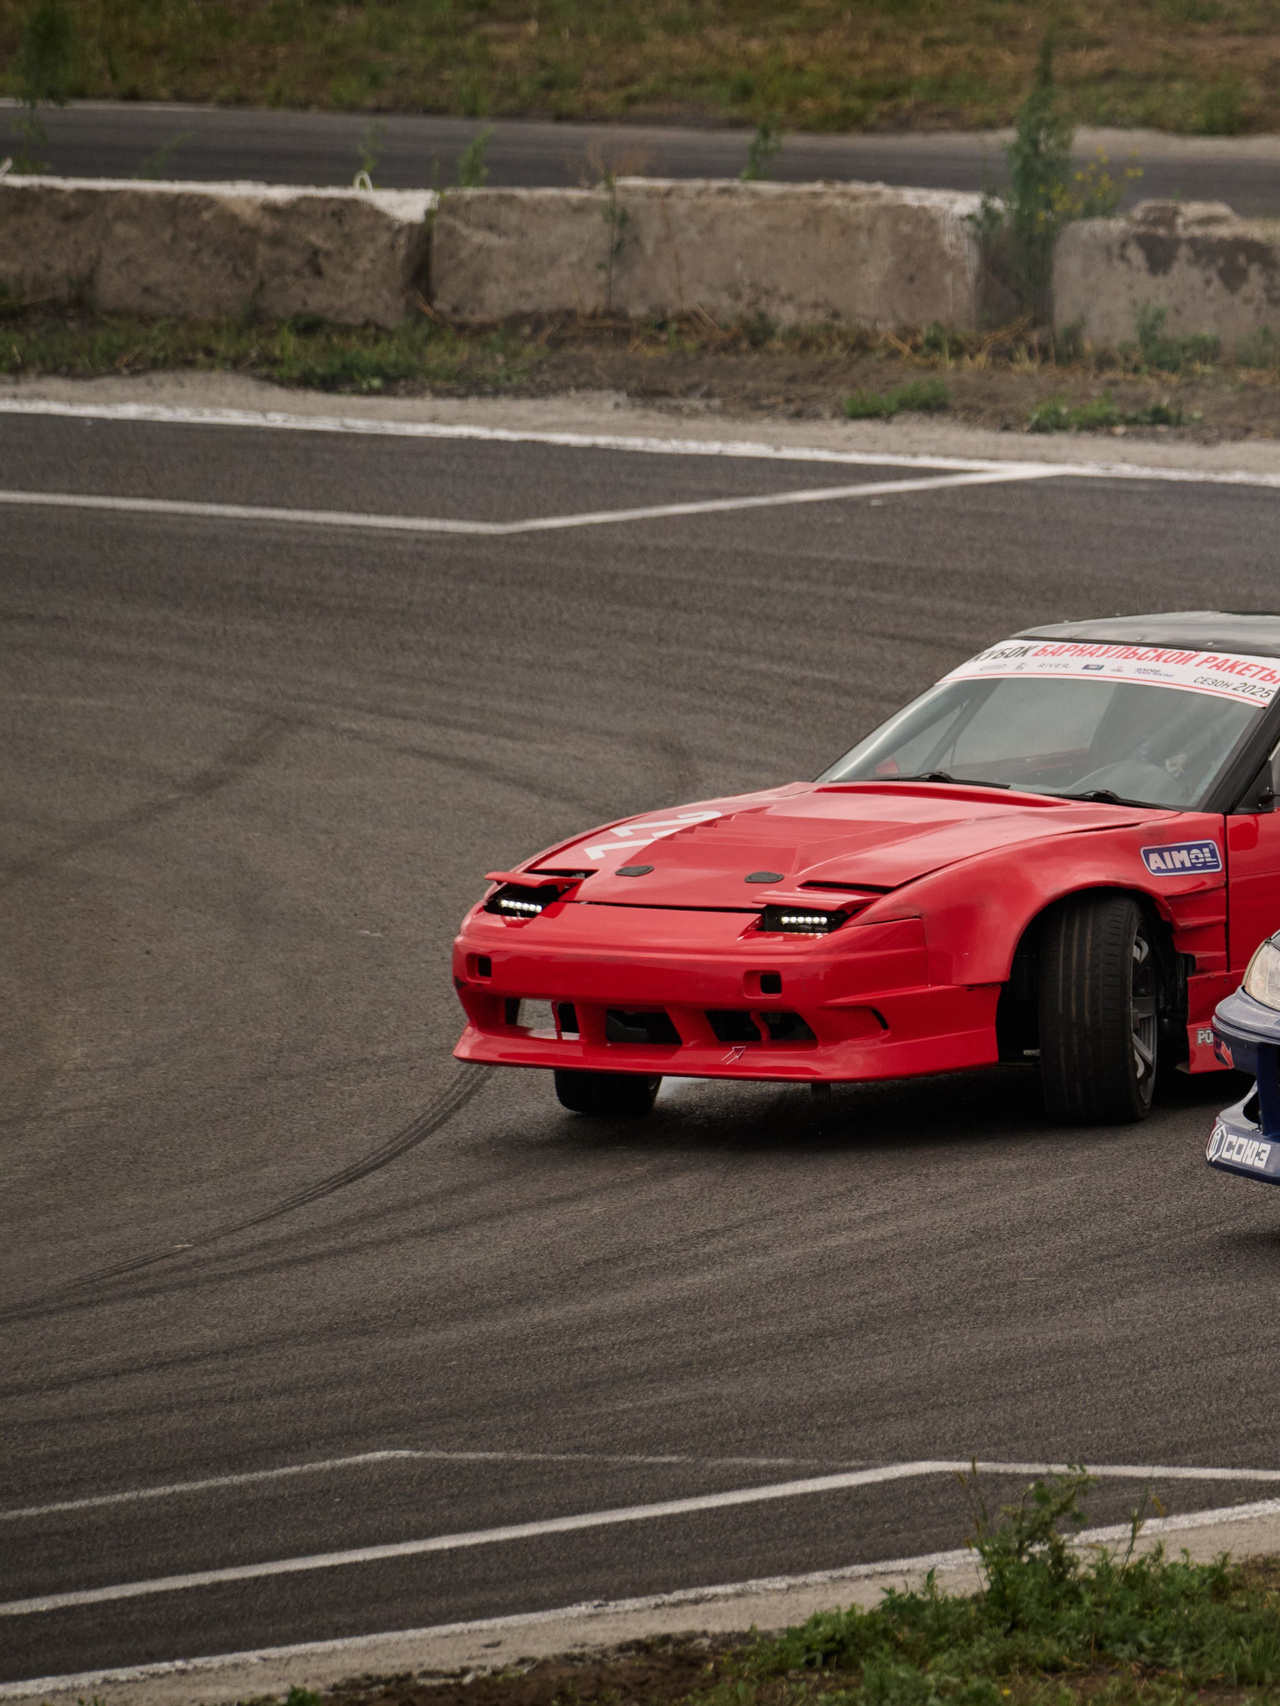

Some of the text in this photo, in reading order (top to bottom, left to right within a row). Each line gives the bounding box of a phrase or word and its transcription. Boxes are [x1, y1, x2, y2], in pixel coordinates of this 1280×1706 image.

[1031, 644, 1200, 667] БАРНАУЛЬСКОЙ
[1193, 676, 1275, 699] СЕЗОН 2025
[1148, 847, 1218, 871] AIMOL
[1223, 1134, 1271, 1169] СОЮЗ
